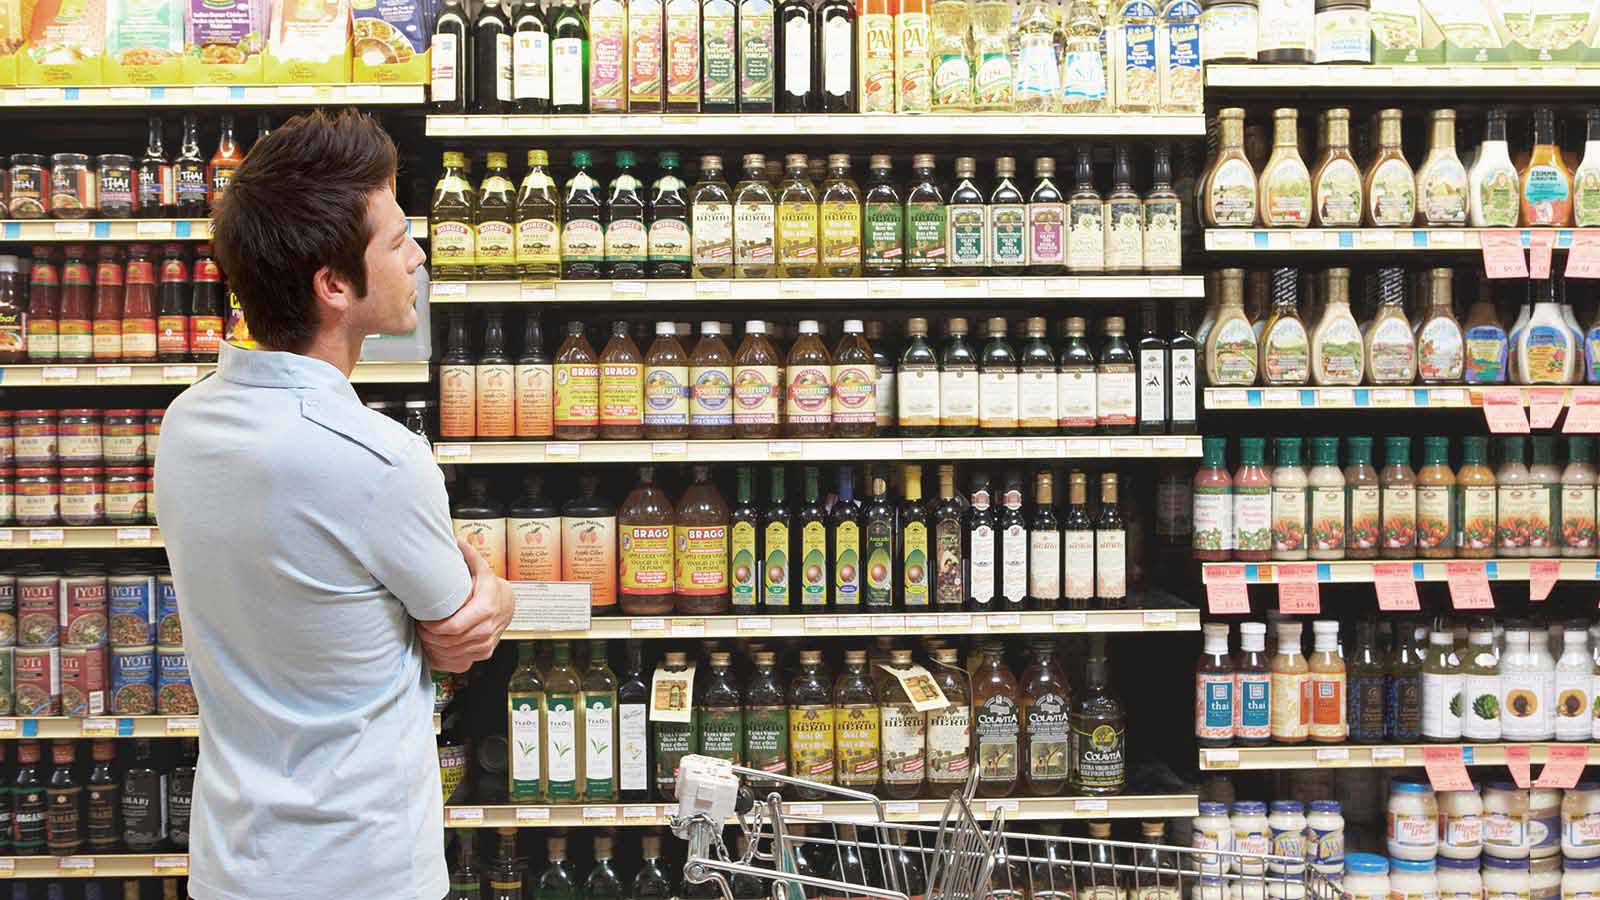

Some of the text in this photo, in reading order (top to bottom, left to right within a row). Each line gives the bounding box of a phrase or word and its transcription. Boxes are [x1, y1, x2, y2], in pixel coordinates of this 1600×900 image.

[181, 170, 204, 182] THAI
[102, 176, 129, 189] THAI
[605, 366, 637, 377] BRAGG
[633, 528, 669, 539] BRAGG
[688, 528, 724, 540] BRAGG
[22, 586, 53, 598] JYOTI
[74, 586, 104, 599] JYOTI
[111, 586, 142, 598] JYOTI
[120, 655, 151, 668] JYOTI
[1211, 701, 1229, 710] thai
[1247, 700, 1266, 710] thai
[978, 713, 1017, 723] COLAVITA
[1029, 711, 1068, 722] COLAVITA
[1084, 749, 1122, 761] COLAVITA
